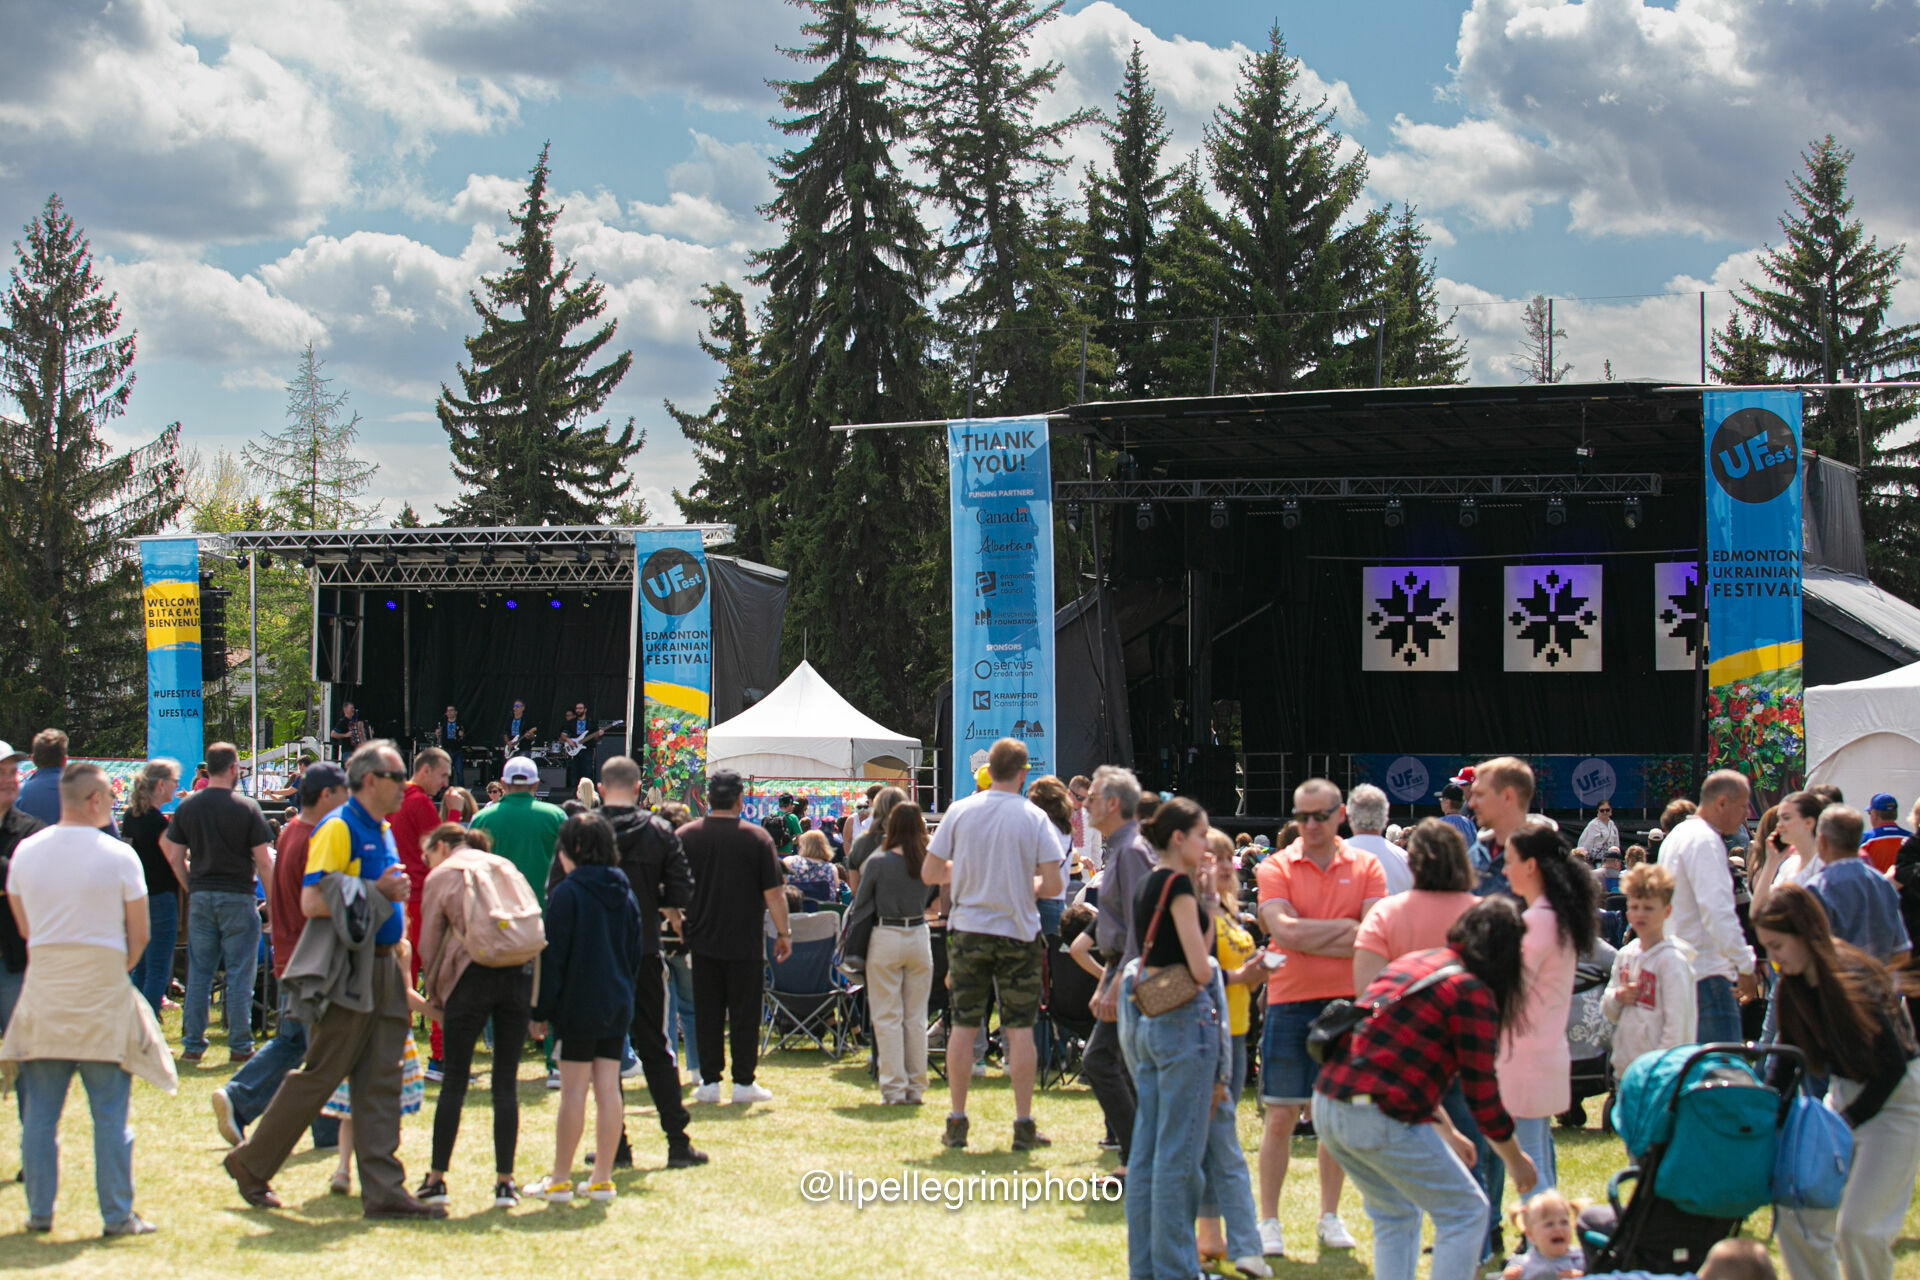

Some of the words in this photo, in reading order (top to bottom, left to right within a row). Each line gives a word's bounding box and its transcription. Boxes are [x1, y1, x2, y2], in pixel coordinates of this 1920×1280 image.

[961, 431, 1036, 452] THANK
[1718, 430, 1794, 480] UFest
[972, 454, 1025, 473] YOU!
[998, 489, 1034, 497] PARTNERS
[976, 507, 1028, 525] Canada
[976, 535, 1025, 554] Alberta
[1712, 550, 1799, 562] EDMONTON
[1712, 566, 1799, 578] UKRAINIAN
[646, 563, 702, 599] UFest
[1713, 582, 1799, 597] FESTIVAL
[645, 630, 708, 640] EDMONTON
[646, 642, 709, 652] UKRAINIAN
[646, 654, 709, 665] FESTIVAL
[993, 661, 1033, 670] servus
[159, 709, 198, 717] UFEST.CA
